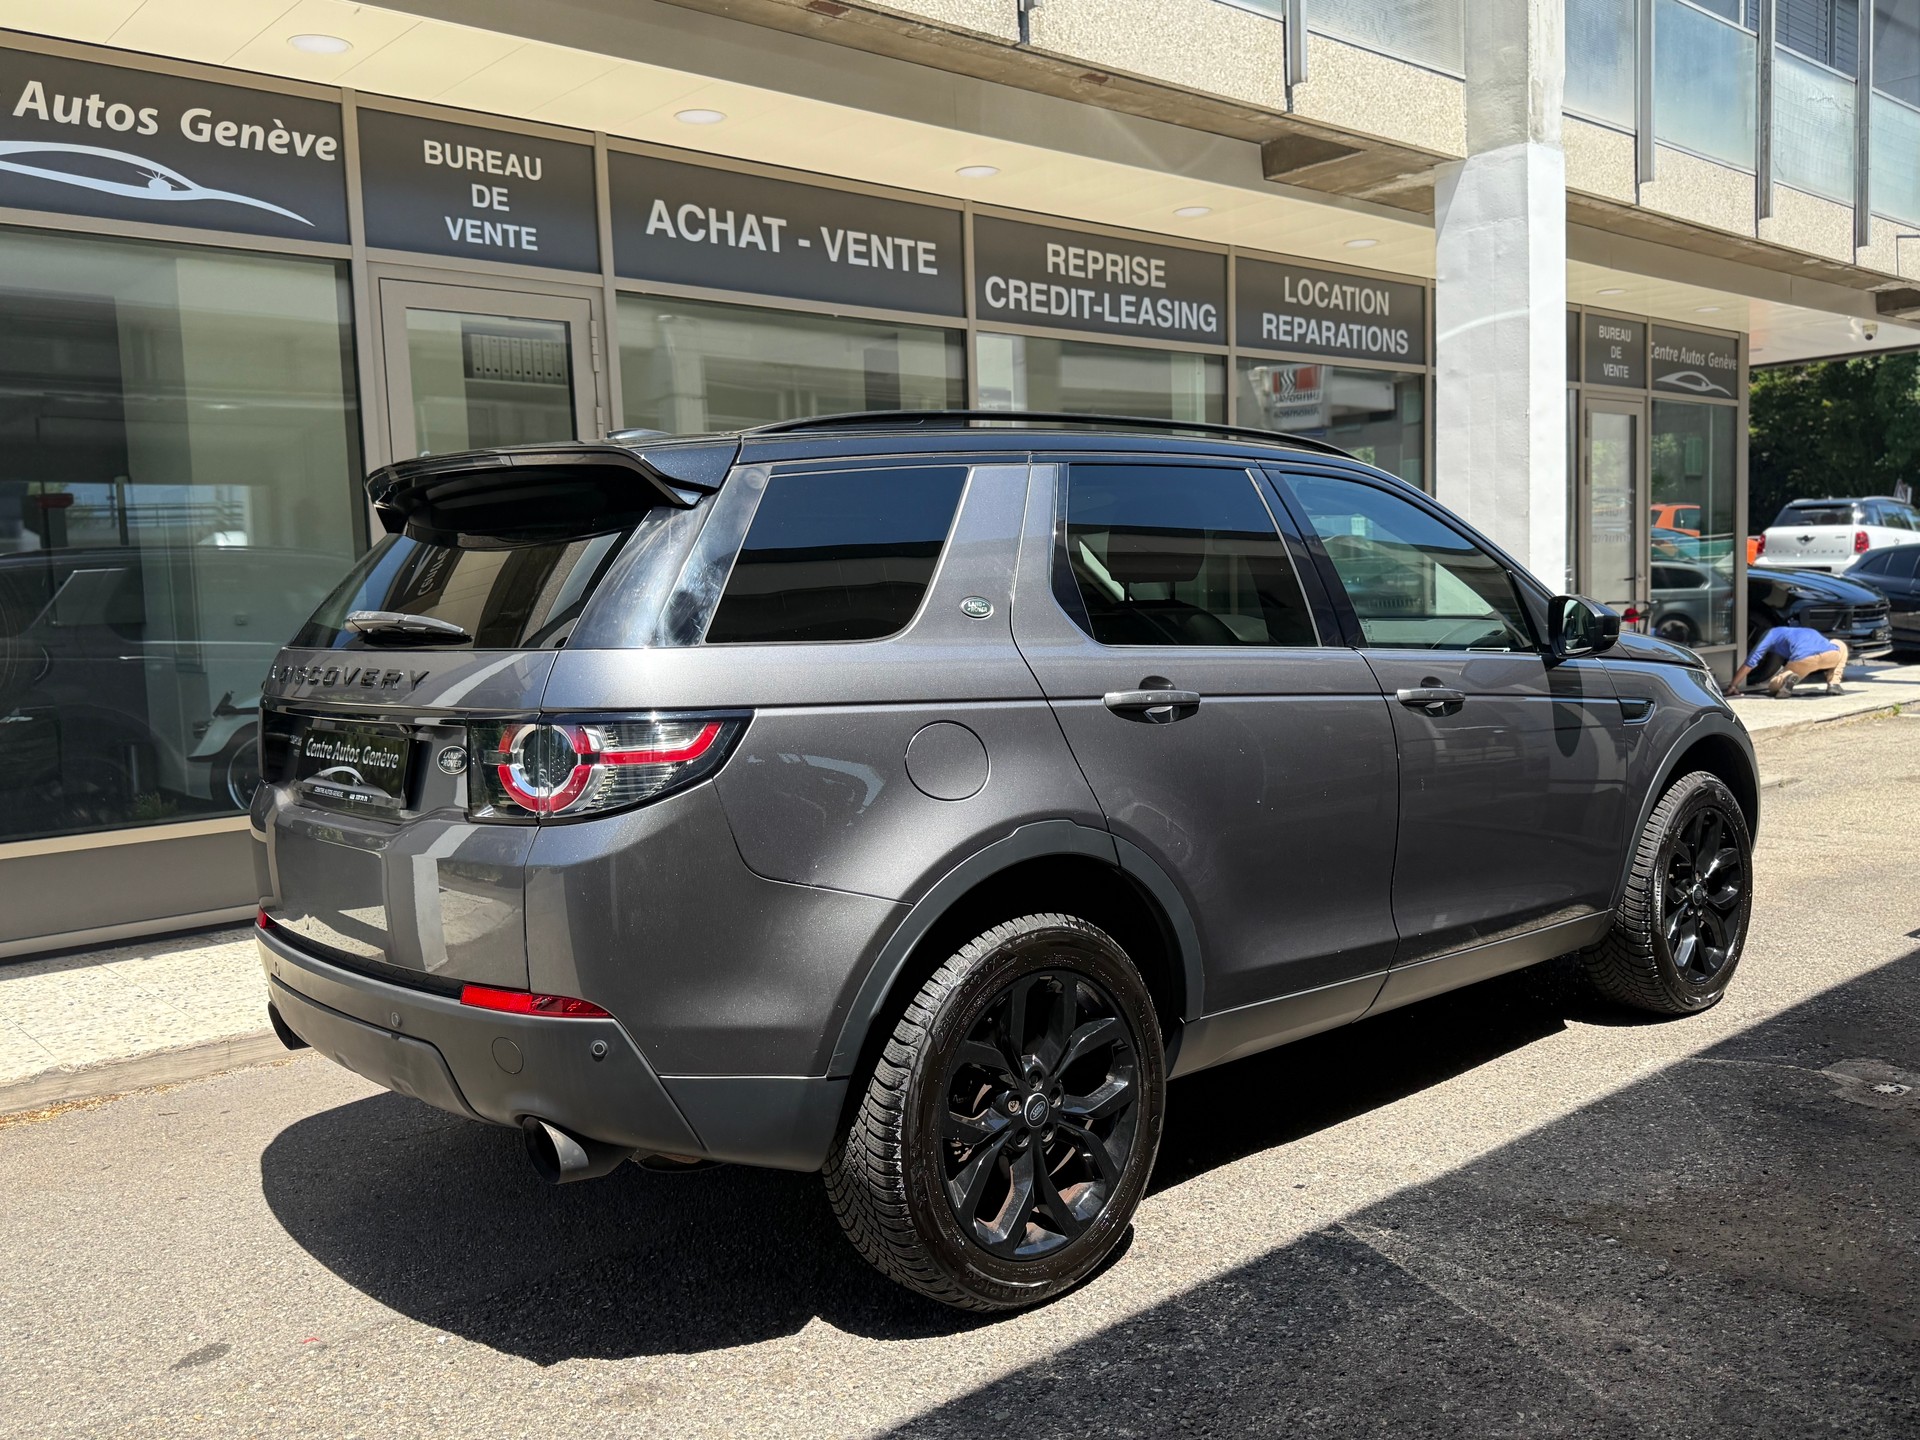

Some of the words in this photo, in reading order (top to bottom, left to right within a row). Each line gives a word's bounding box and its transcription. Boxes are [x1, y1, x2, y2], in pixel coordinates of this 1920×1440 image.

[12, 80, 159, 136] Autos
[180, 107, 338, 161] Genève
[423, 139, 543, 181] BUREAU
[472, 184, 510, 211] DE
[444, 216, 539, 251] VENTE
[645, 199, 787, 253] ACHAT
[820, 226, 938, 276] VENTE
[1046, 242, 1166, 289] REPRISE
[985, 276, 1217, 333] CREDIT-LEASING
[1284, 276, 1389, 316] LOCATION
[1262, 312, 1409, 355] REPARATIONS
[1599, 325, 1632, 343] BUREAU
[1610, 346, 1622, 359] DE
[1679, 346, 1705, 366] Autos
[1707, 352, 1737, 370] Genève
[1603, 363, 1629, 379] VENTE
[279, 666, 430, 691] DISCOVERY
[306, 737, 333, 760] Centre
[331, 741, 359, 765] Autos
[362, 746, 399, 769] Genève
[443, 751, 459, 760] LAND
[443, 759, 462, 768] ROVER
